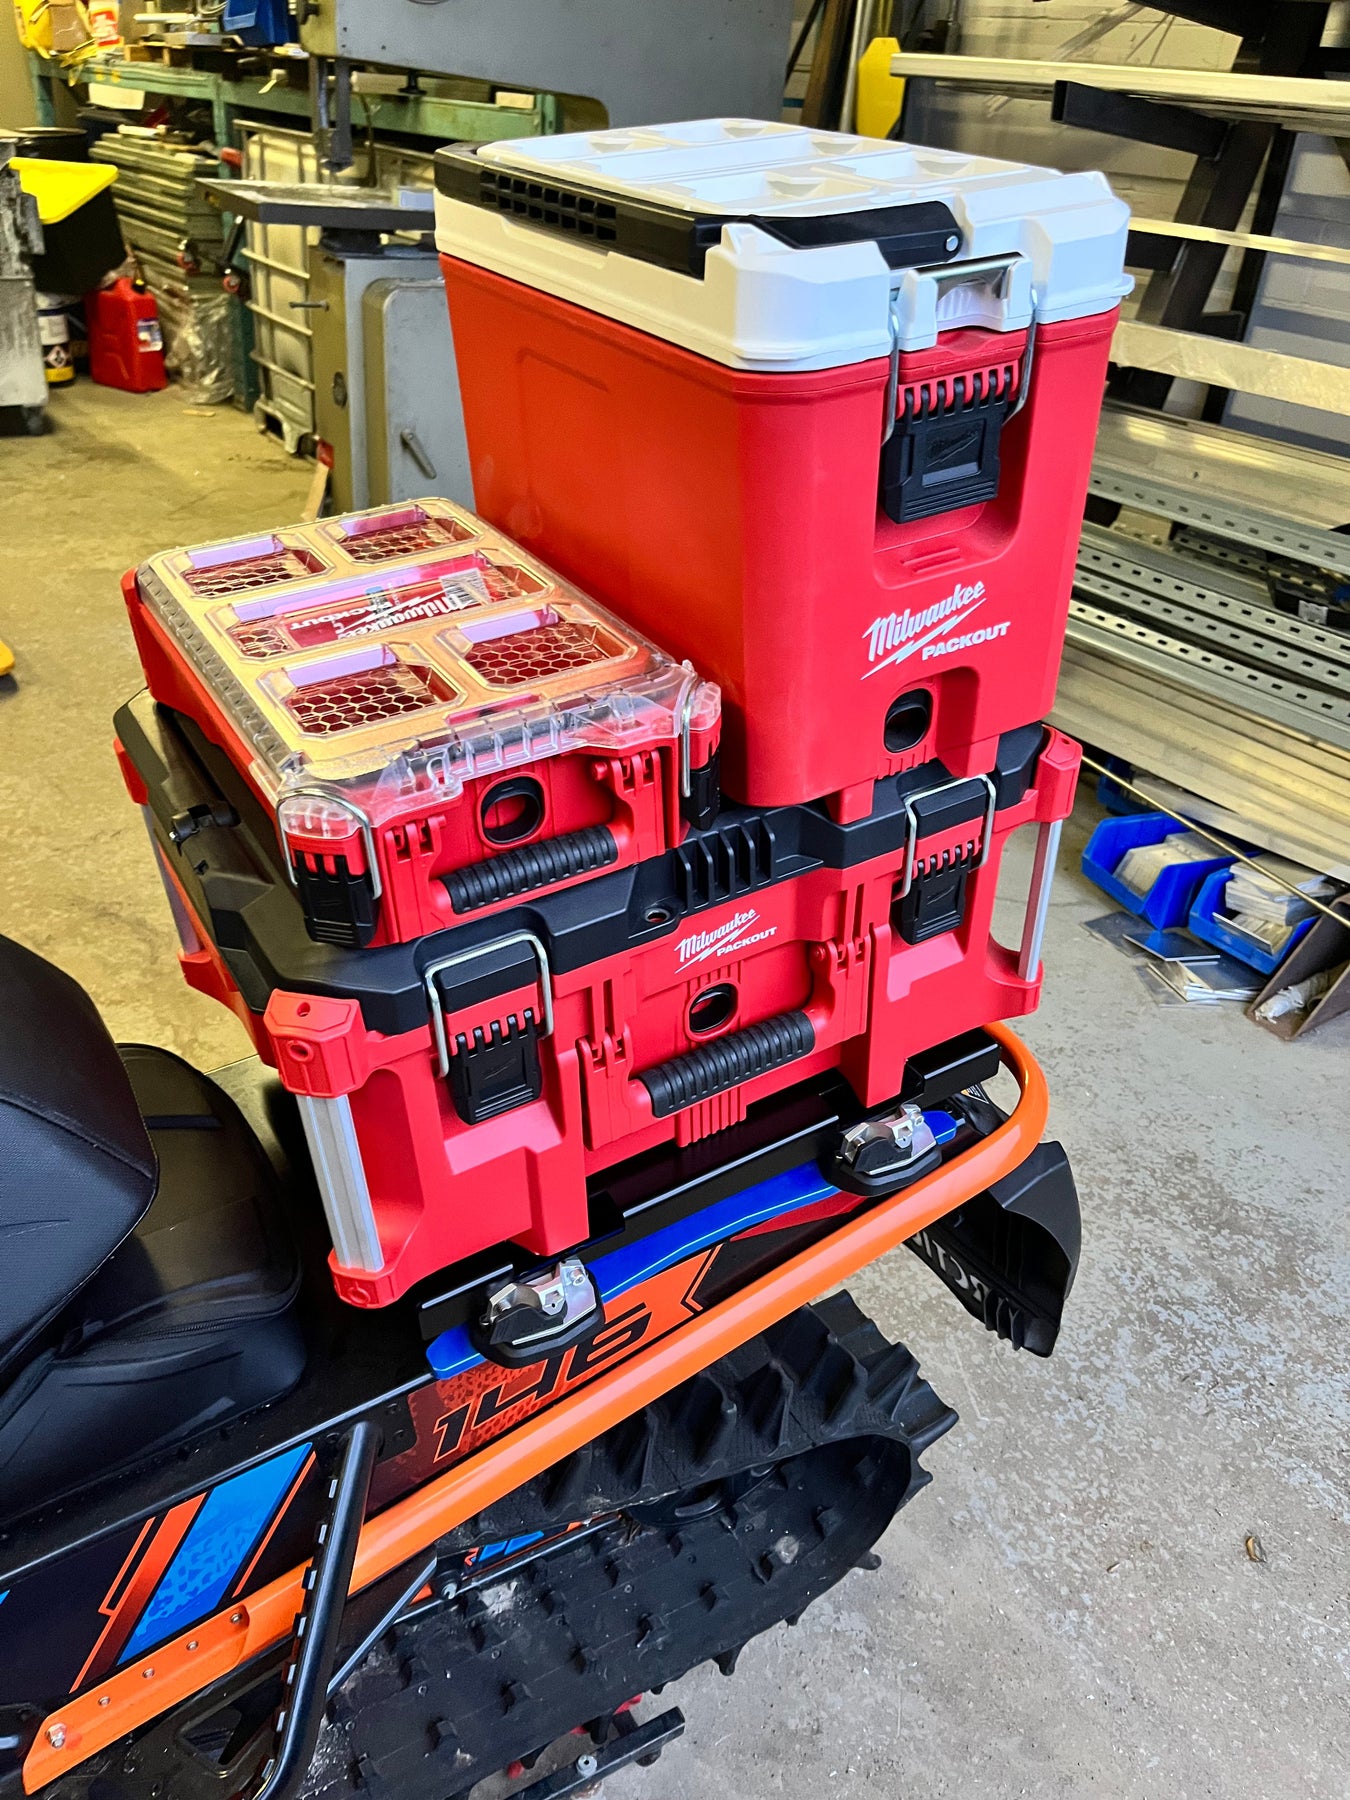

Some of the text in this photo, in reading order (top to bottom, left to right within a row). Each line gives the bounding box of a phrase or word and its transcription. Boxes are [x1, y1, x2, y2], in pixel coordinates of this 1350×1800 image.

[862, 580, 985, 662] Milwaukee
[921, 621, 1011, 661] PACKOUT
[674, 908, 757, 962] Milwaukee
[716, 926, 778, 957] PACKOUT
